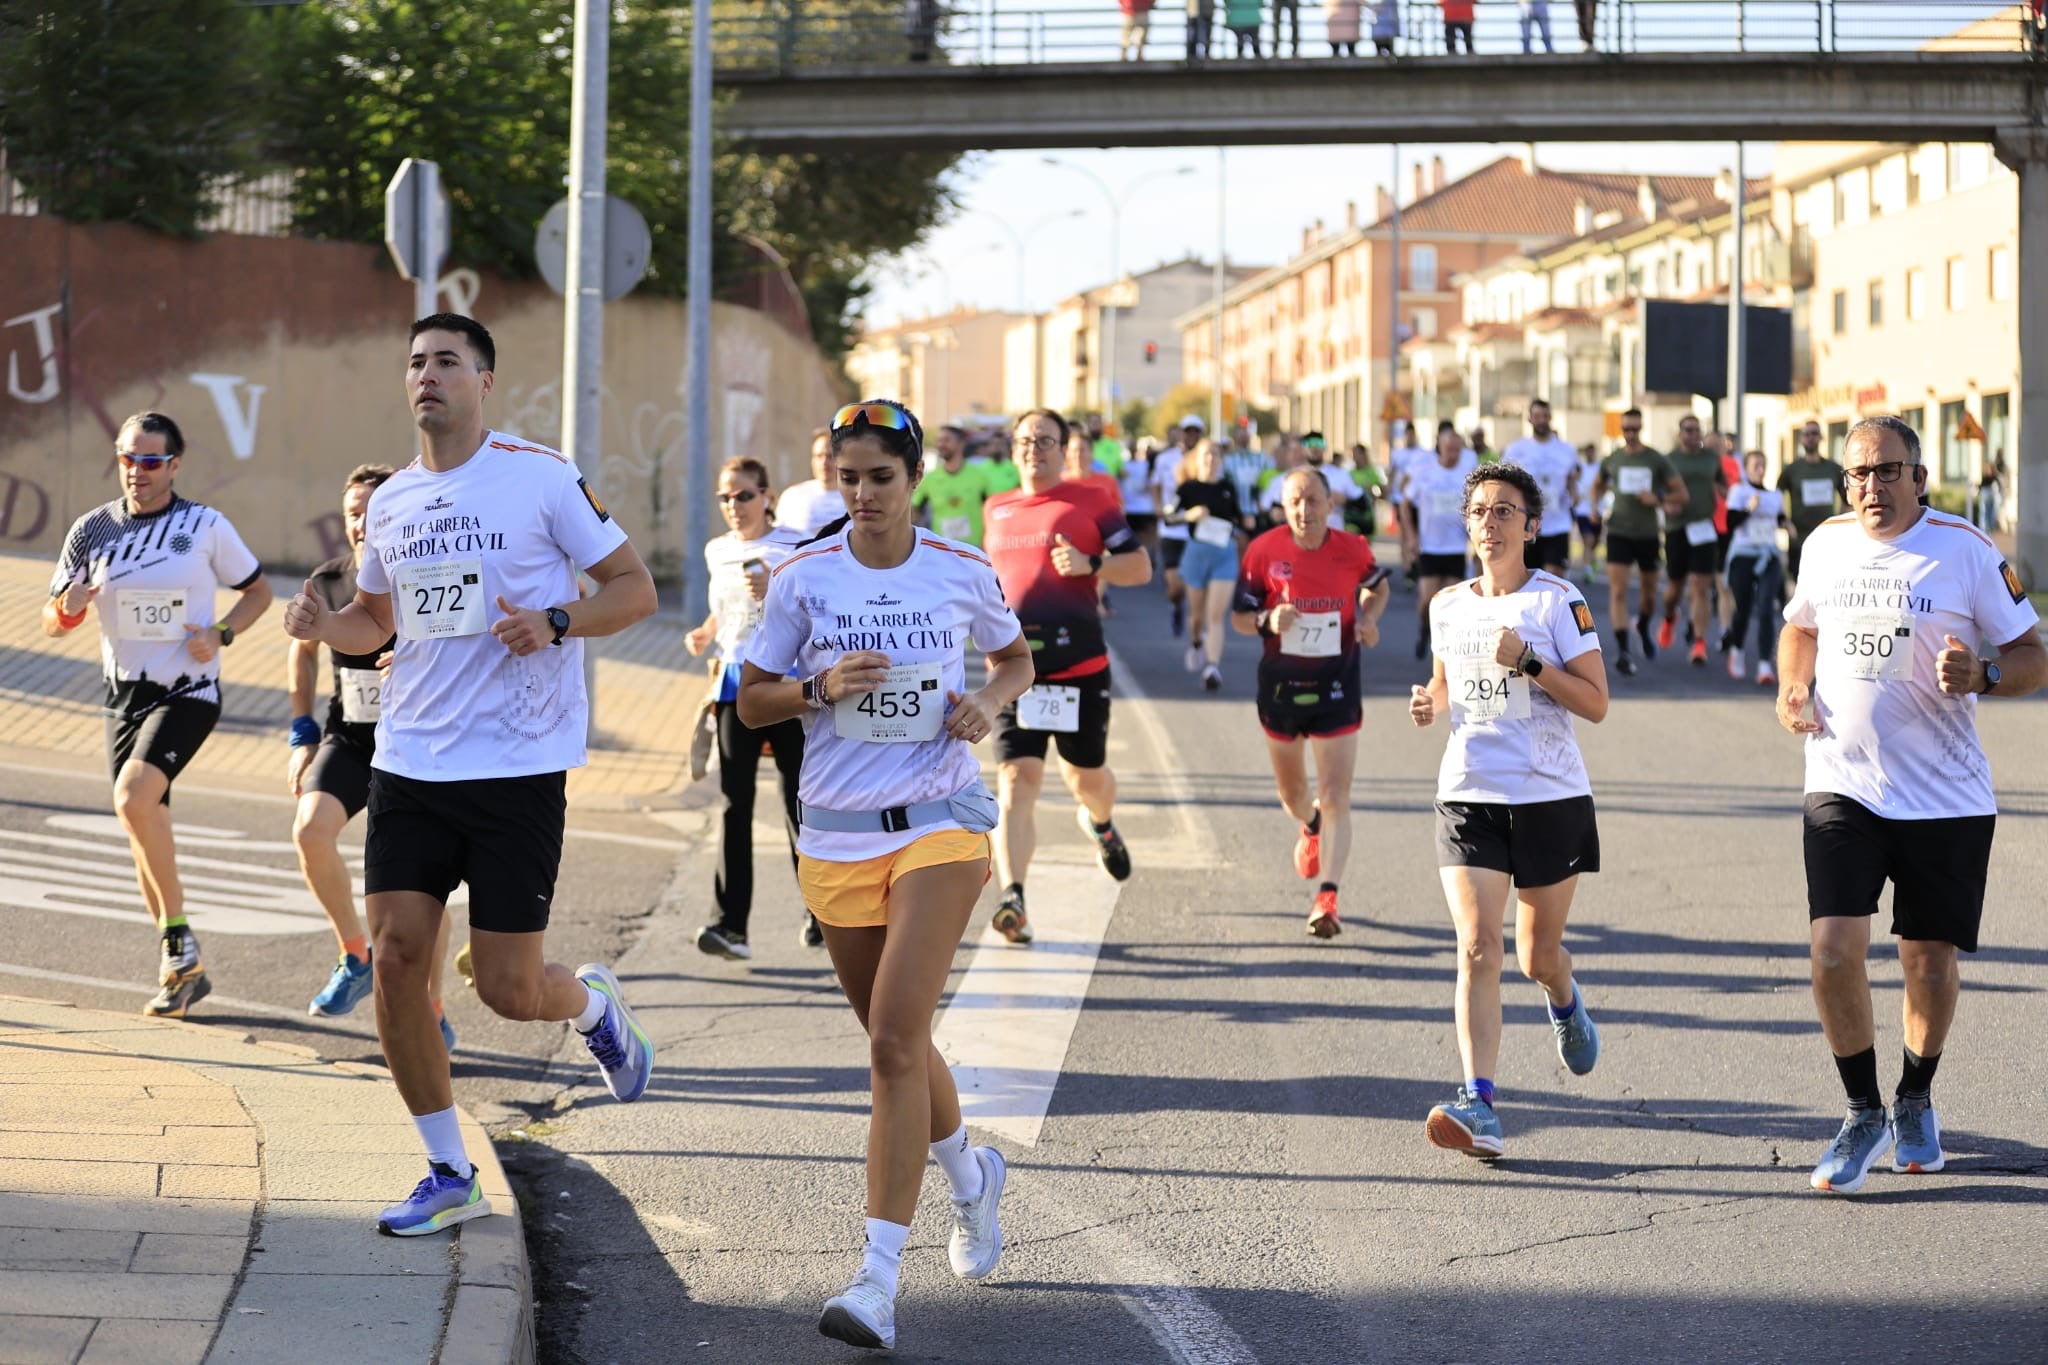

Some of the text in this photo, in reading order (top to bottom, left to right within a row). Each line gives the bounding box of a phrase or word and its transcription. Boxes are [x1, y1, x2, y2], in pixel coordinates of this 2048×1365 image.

[188, 371, 266, 460] V
[403, 516, 481, 539] III CARRERA
[455, 533, 508, 552] CIVIL
[1850, 578, 1912, 592] CARRERA
[415, 585, 464, 615] 272
[1887, 594, 1935, 614] CIVIL
[133, 606, 172, 624] 130
[836, 611, 934, 629] III CARRERA
[1299, 627, 1322, 643] 77
[1843, 632, 1893, 658] 350
[357, 687, 381, 705] 12
[1464, 677, 1510, 701] 294
[857, 690, 920, 718] 453
[1038, 699, 1060, 716] 78
